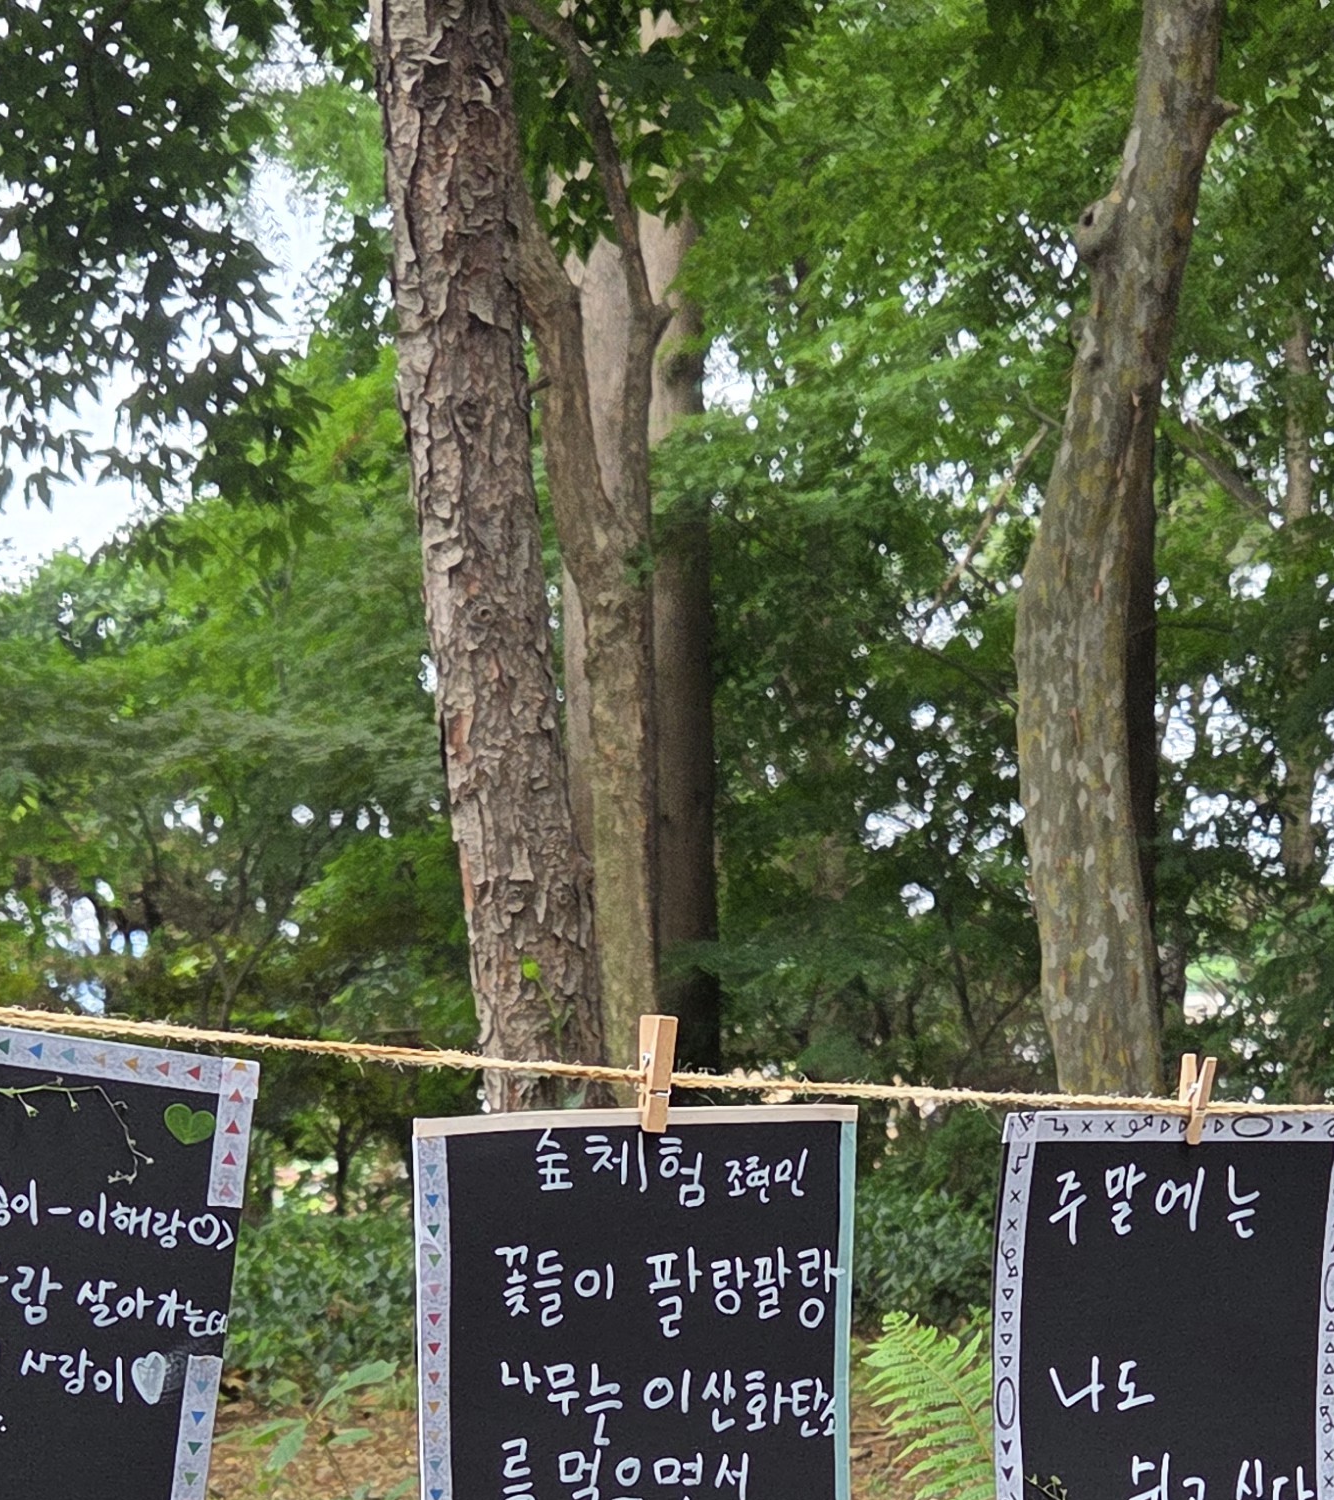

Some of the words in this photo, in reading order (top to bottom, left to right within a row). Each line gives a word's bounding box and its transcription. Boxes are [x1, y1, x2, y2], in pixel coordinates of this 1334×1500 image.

[494, 1245, 614, 1327] 꽃들이
[645, 1244, 847, 1338] 팔랑팔랑
[20, 1348, 124, 1404] 사랑이
[500, 1361, 623, 1446] 나무는
[1048, 1355, 1156, 1413] 나도
